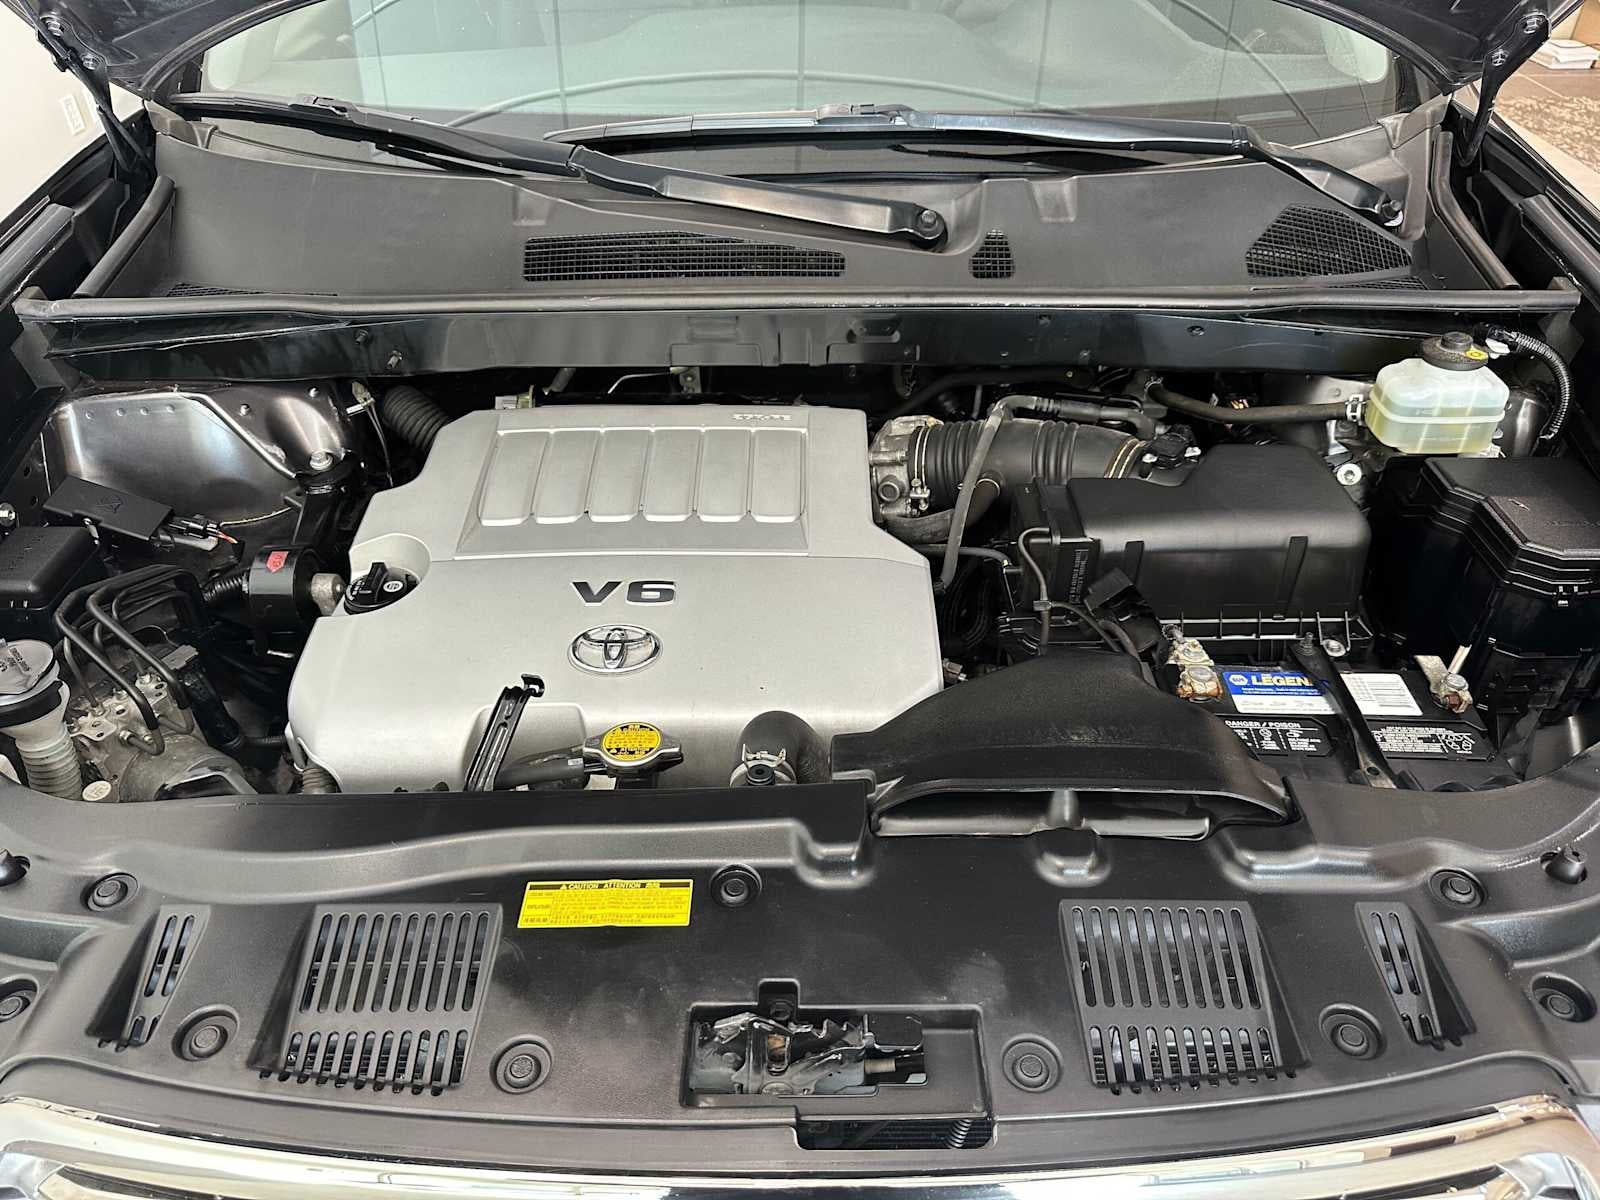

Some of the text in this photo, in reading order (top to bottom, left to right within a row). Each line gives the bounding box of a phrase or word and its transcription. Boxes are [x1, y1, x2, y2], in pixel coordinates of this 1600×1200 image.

[571, 579, 675, 604] V6
[1251, 675, 1313, 687] LEGEN
[1224, 719, 1261, 728] DANGER
[1268, 721, 1301, 729] POISON
[603, 881, 641, 889] ATTENTION
